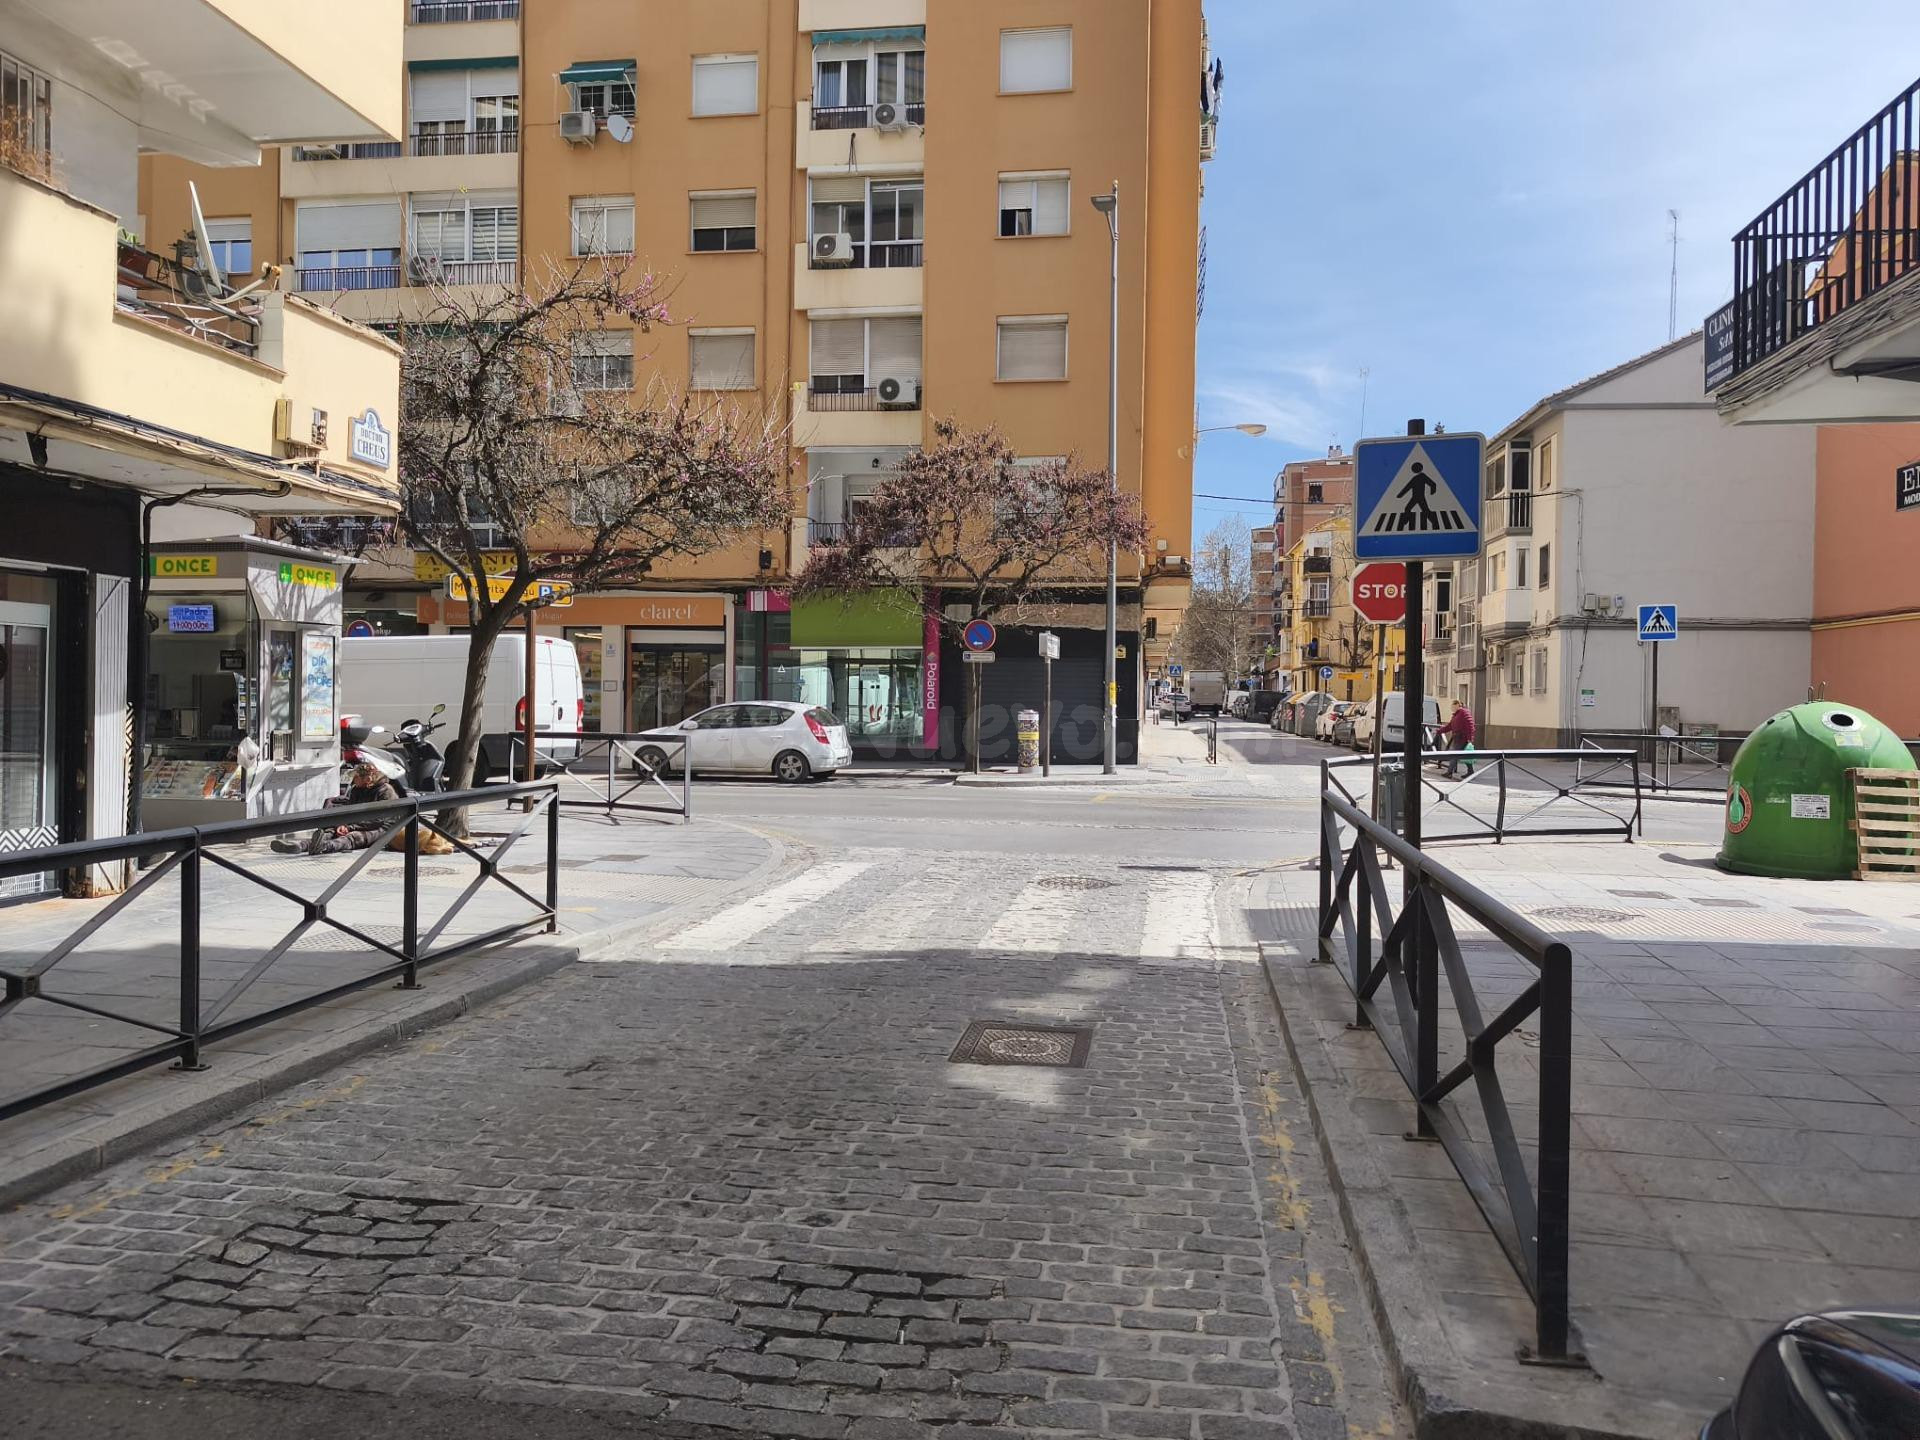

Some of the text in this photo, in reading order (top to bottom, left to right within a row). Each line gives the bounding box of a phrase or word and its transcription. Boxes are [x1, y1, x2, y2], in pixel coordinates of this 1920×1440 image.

[163, 559, 210, 573] ONCE
[296, 567, 331, 583] ONCE
[640, 603, 691, 620] clarel
[926, 662, 937, 710] Polaroid
